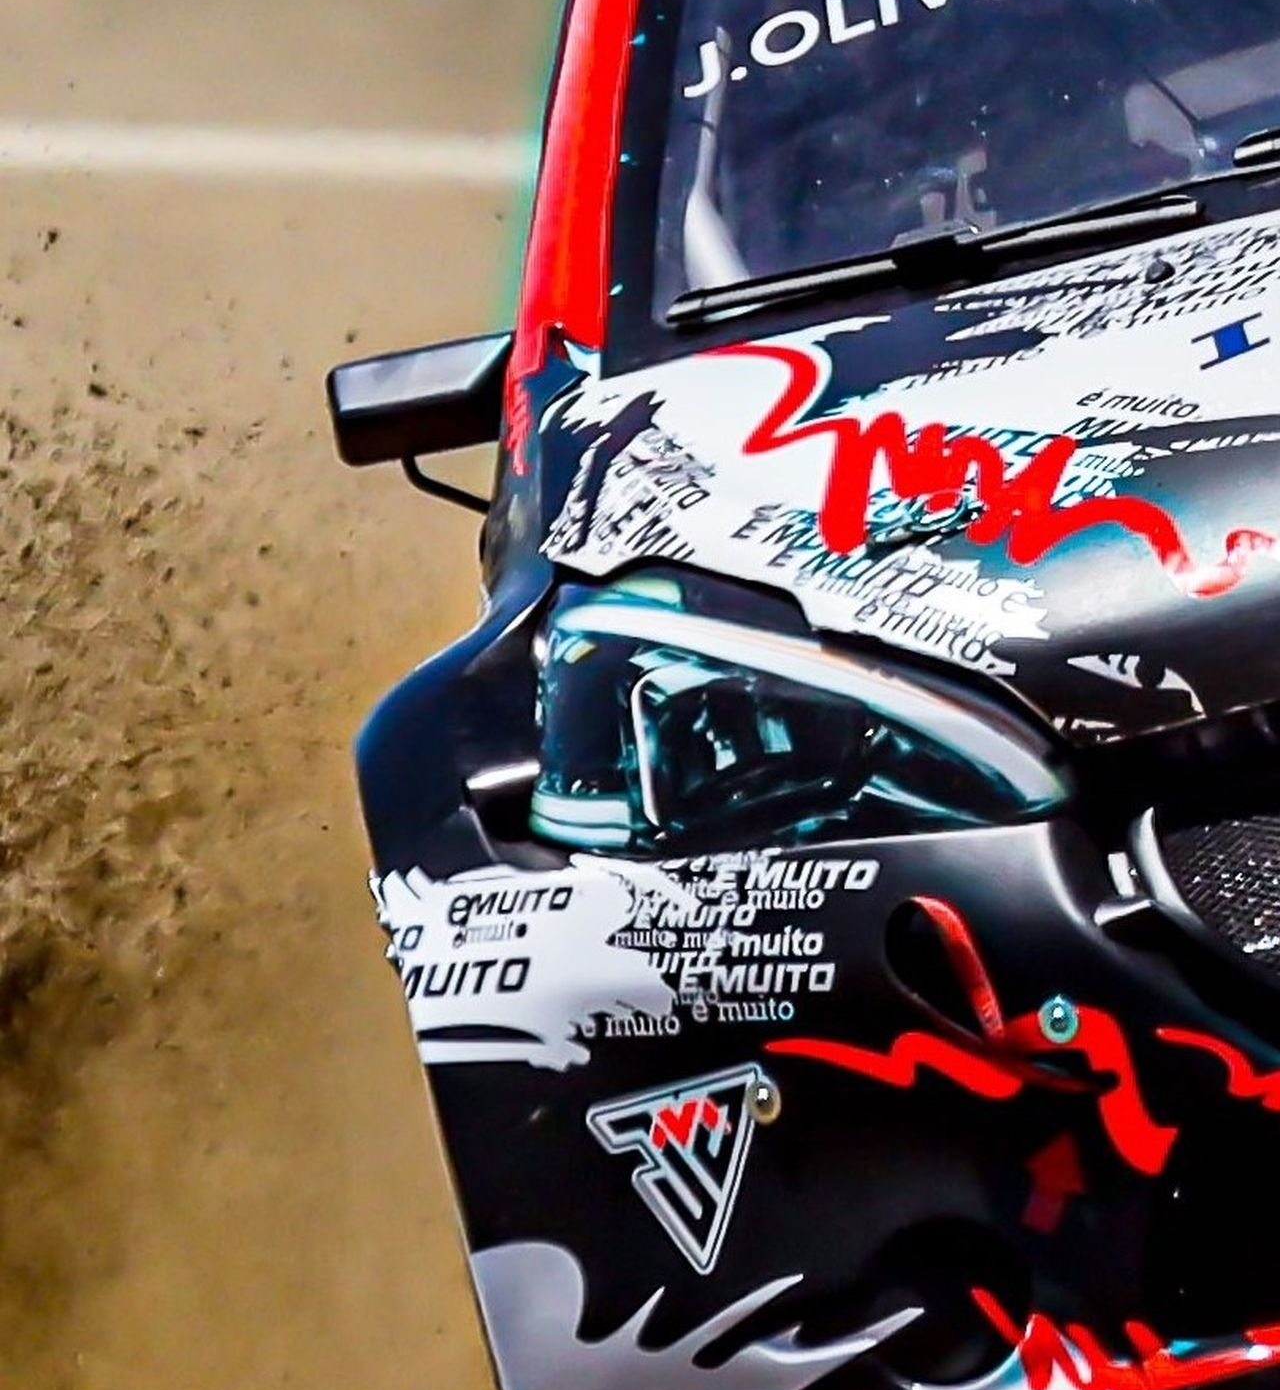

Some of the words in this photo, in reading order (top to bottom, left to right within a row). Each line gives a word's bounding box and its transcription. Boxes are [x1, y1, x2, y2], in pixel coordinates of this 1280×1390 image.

[1101, 393, 1200, 419] muito
[744, 860, 880, 890] MUITO
[749, 888, 824, 909] muito
[731, 925, 824, 957] muito
[711, 963, 836, 993] MUITO
[717, 996, 795, 1022] muito
[604, 1013, 682, 1037] muito
